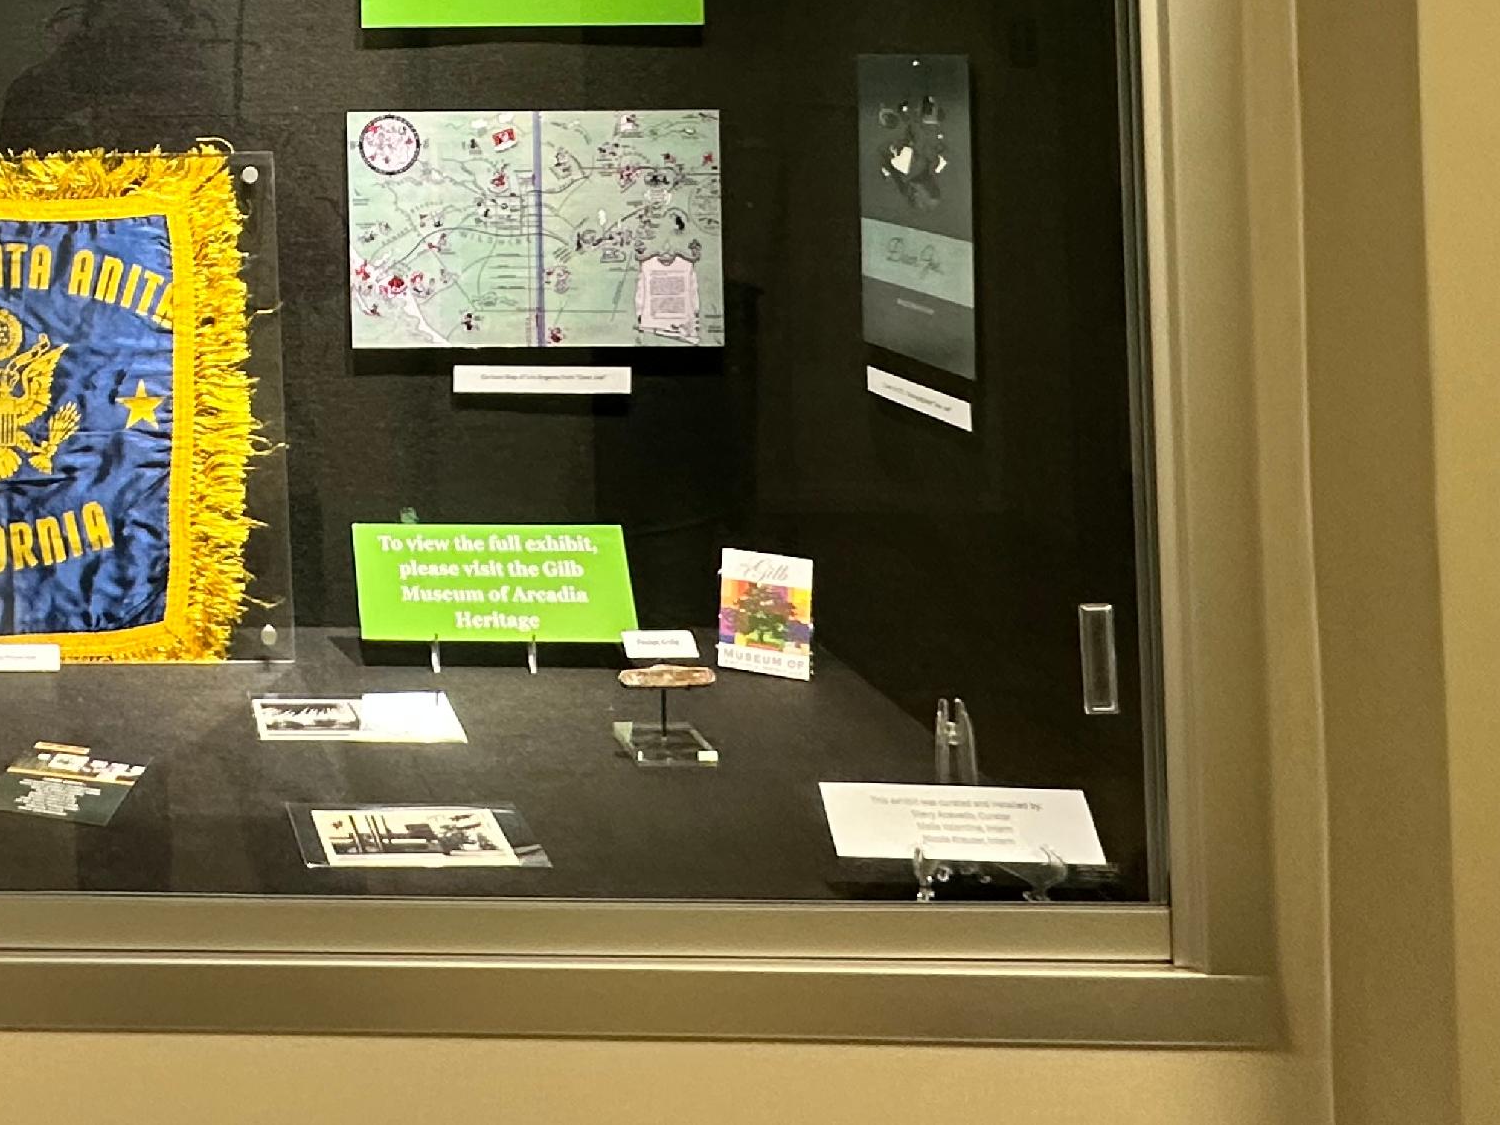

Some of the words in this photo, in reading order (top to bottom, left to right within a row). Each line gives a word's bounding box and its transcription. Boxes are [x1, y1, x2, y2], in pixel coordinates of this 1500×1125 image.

[69, 249, 174, 329] ANITA
[377, 535, 403, 552] To
[406, 535, 450, 552] view
[453, 535, 485, 551] the
[488, 534, 522, 551] full
[525, 534, 598, 554] exhibit,
[399, 560, 460, 580] please
[462, 560, 504, 577] visit
[507, 560, 539, 577] the
[542, 560, 584, 577] Gilb
[401, 586, 485, 603] Museum
[488, 585, 510, 602] of
[512, 586, 589, 603] Arcadia
[454, 611, 540, 632] Heritage
[723, 647, 783, 667] MUSEUM
